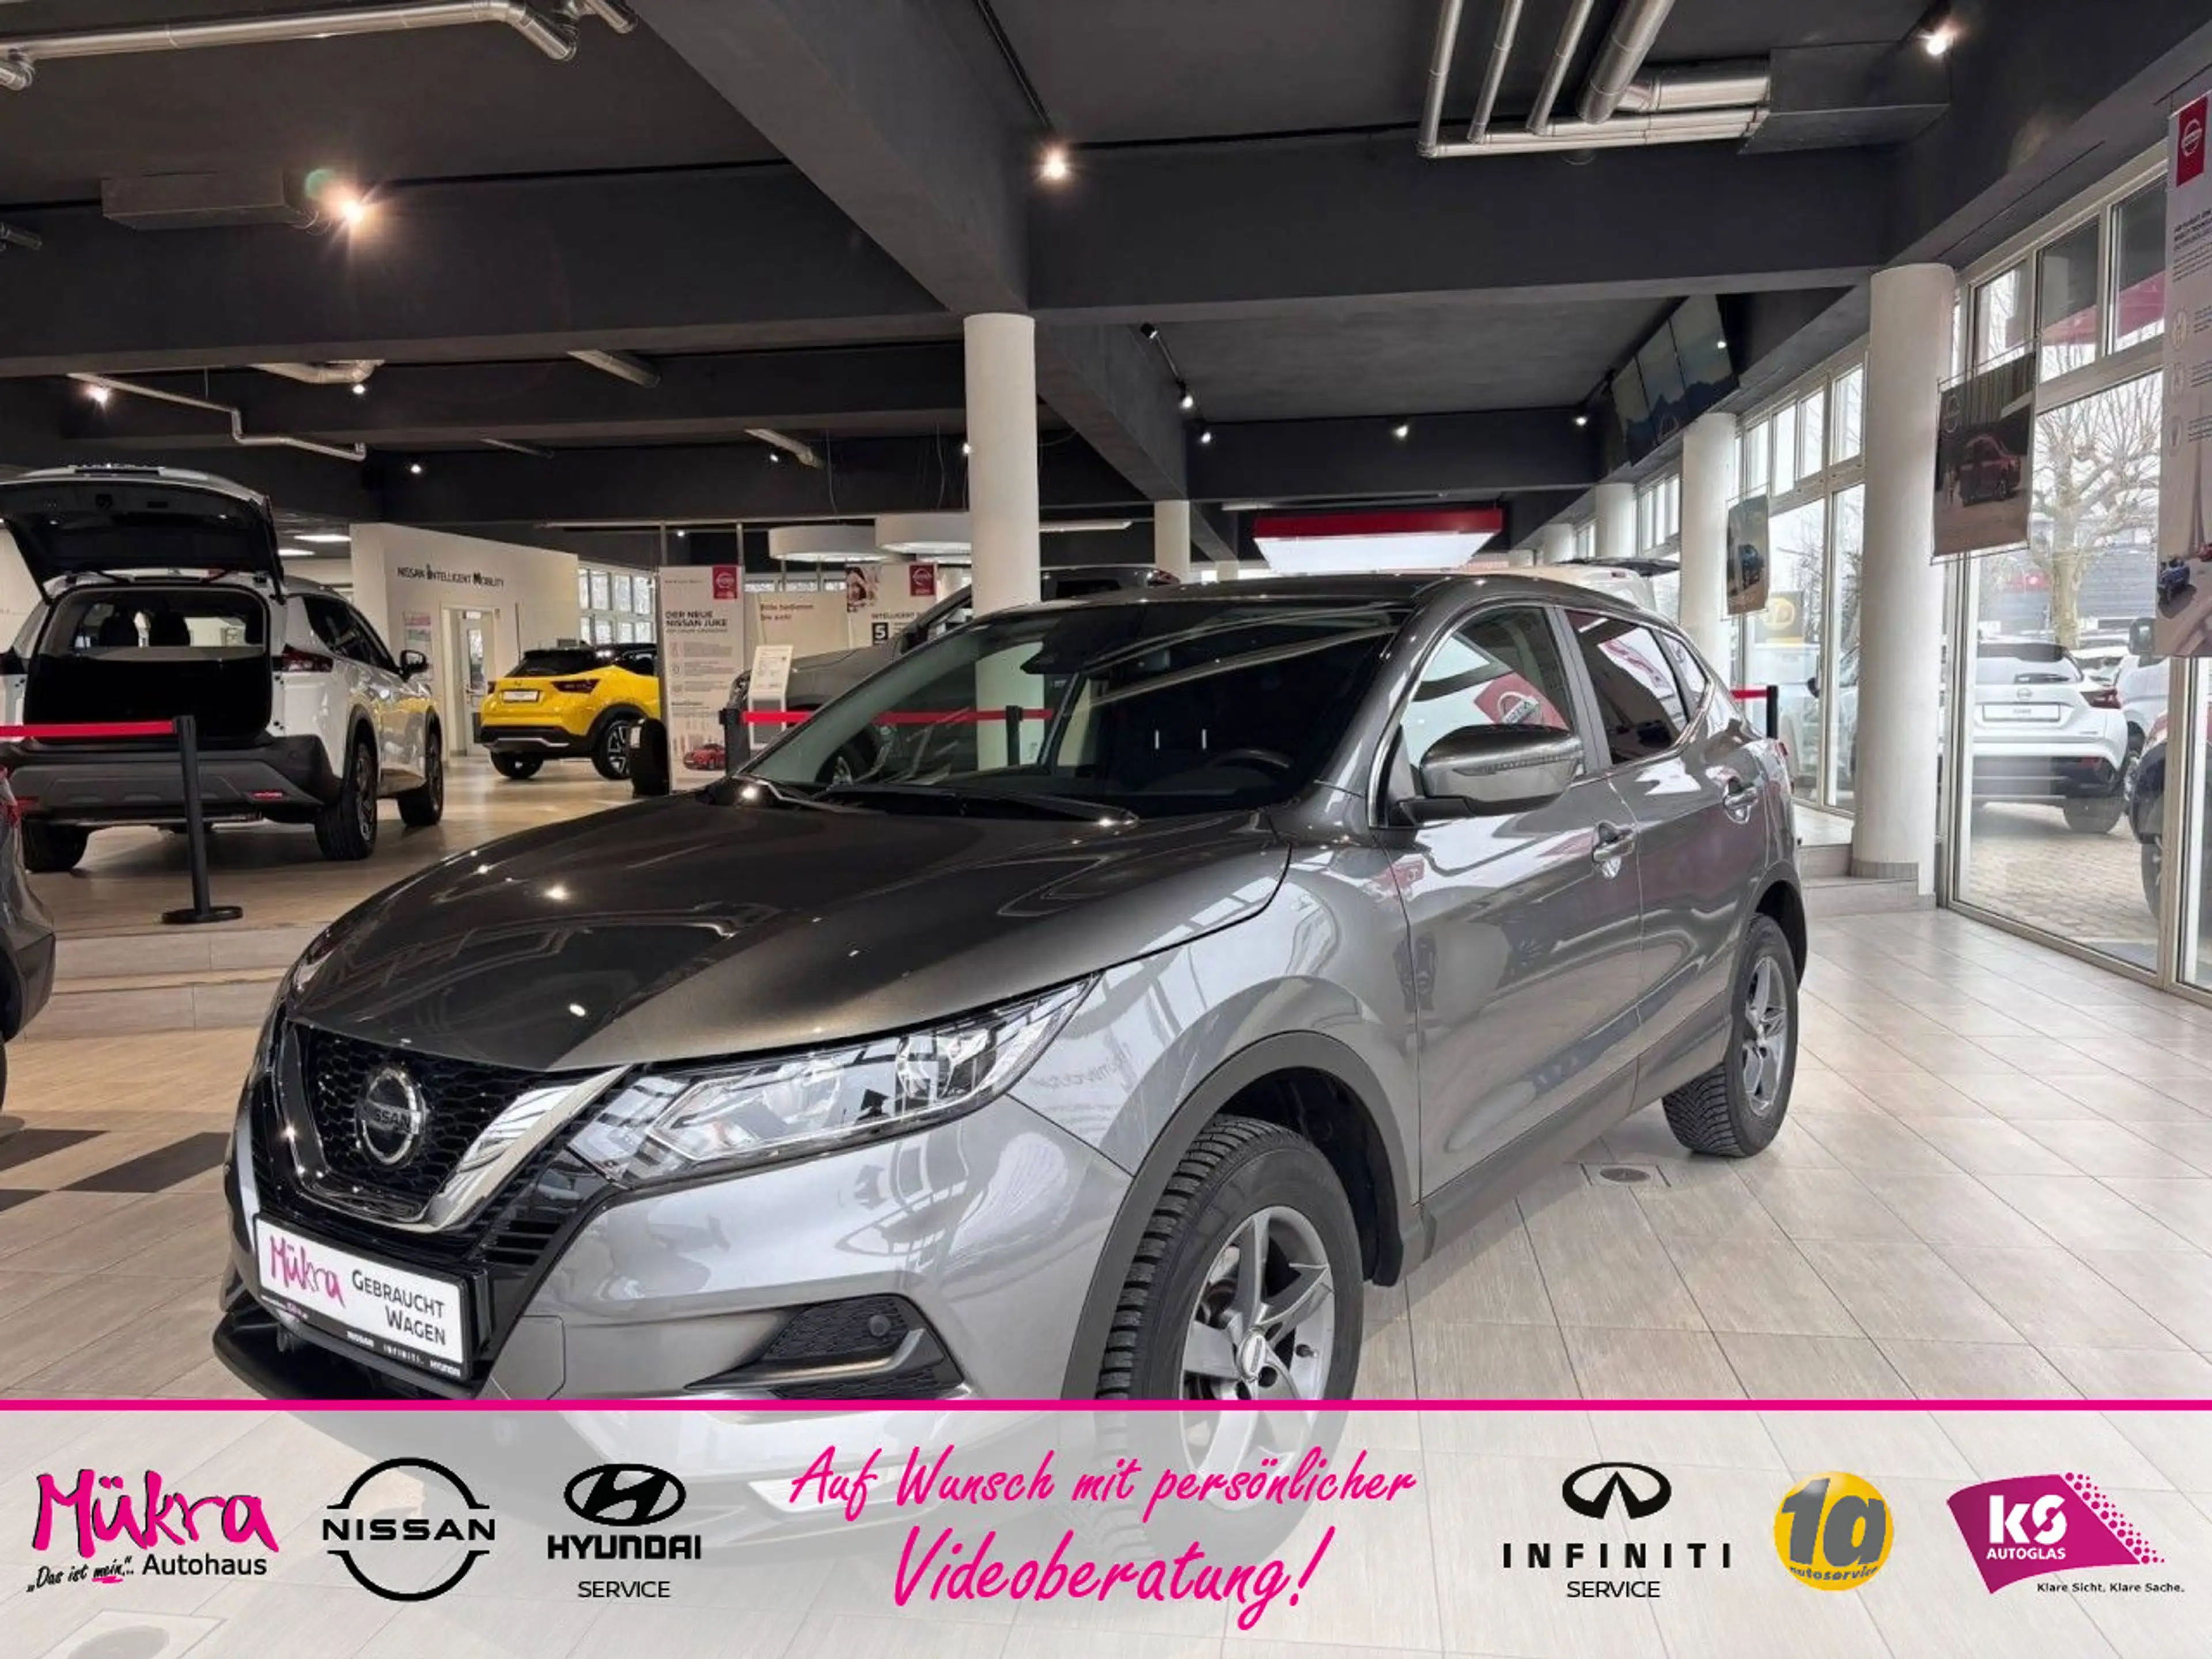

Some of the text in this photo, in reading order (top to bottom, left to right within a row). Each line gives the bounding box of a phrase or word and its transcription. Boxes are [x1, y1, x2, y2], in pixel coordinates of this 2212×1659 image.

[704, 619, 728, 627] JUKE
[874, 624, 886, 639] 5
[270, 1235, 346, 1309] Mükra
[351, 1270, 444, 1319] GEBRAUCHT
[385, 1305, 446, 1346] WAGEN
